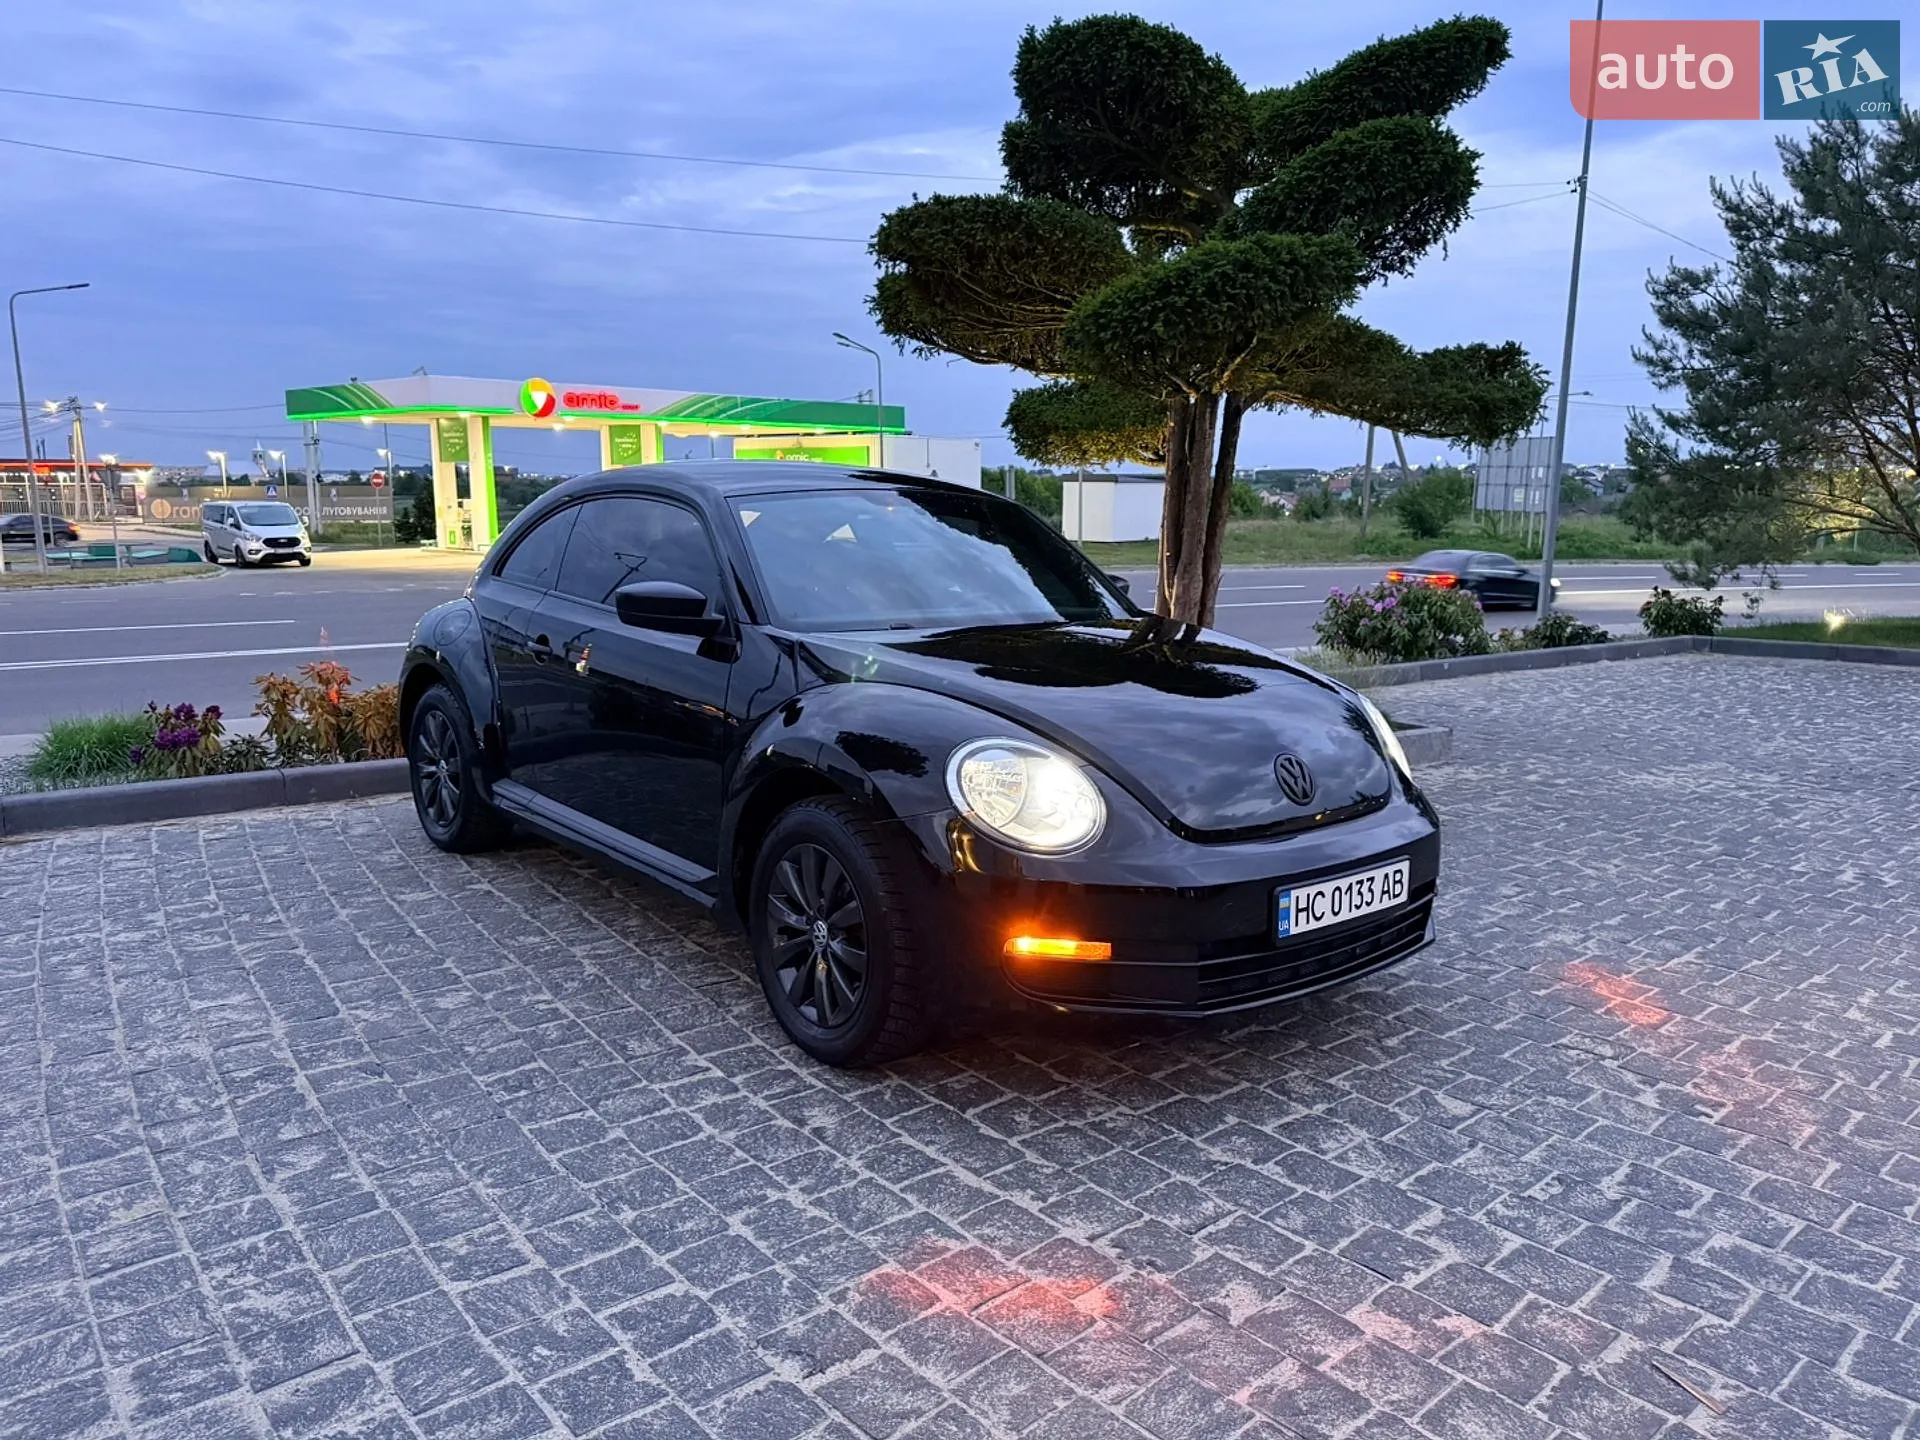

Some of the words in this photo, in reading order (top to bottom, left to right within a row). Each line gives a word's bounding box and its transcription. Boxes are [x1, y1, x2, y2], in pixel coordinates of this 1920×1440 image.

[1295, 890, 1326, 928] HC
[1331, 876, 1376, 917] 0133
[1379, 868, 1404, 904] AB
[1278, 919, 1290, 931] UA
